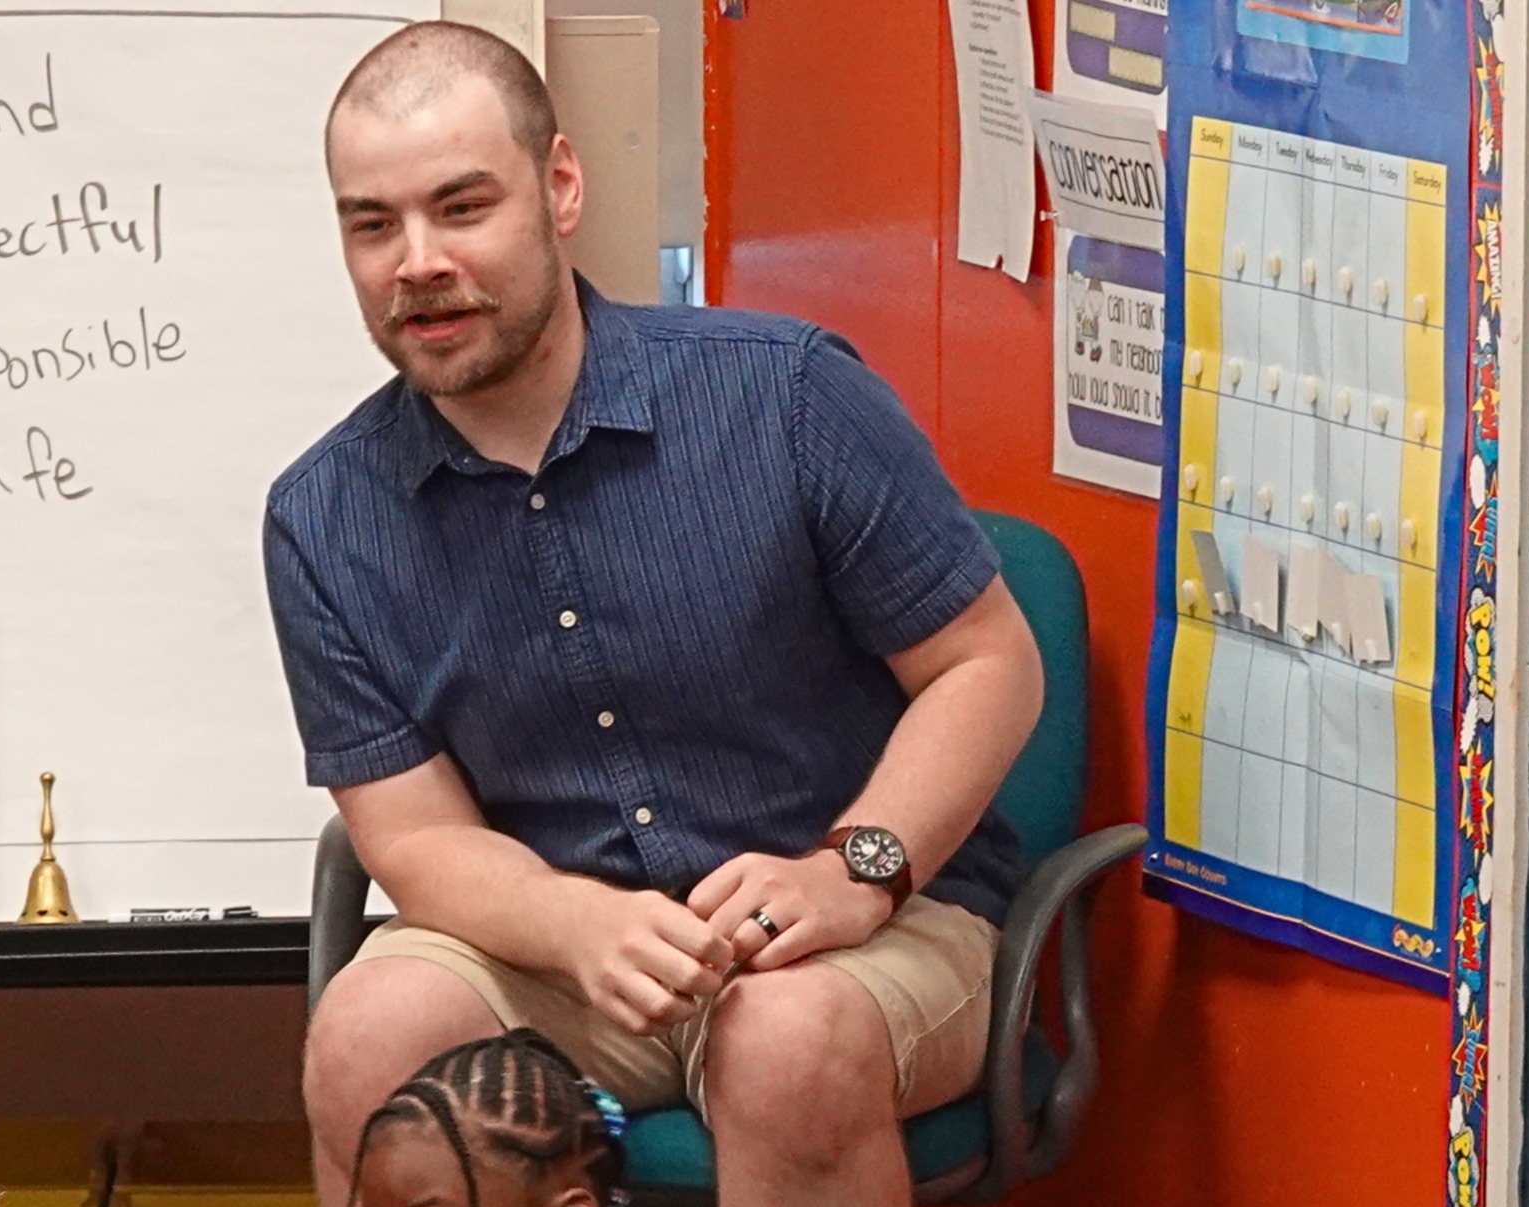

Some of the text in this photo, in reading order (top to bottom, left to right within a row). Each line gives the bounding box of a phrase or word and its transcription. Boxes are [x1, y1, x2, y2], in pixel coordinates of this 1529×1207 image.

[1200, 128, 1224, 149] Sunday
[1238, 135, 1263, 157] Monday
[1276, 141, 1298, 164] Tuesday
[1049, 140, 1162, 211] conversation
[1341, 155, 1366, 179] Thursday
[1378, 163, 1398, 186] Friday
[1413, 170, 1441, 195] Saturday
[1485, 220, 1501, 299] AMAZING!
[1107, 294, 1125, 325] can
[1128, 300, 1132, 328] i
[1136, 301, 1156, 331] talk
[1110, 339, 1122, 367] my
[1090, 378, 1108, 406] loud
[1112, 382, 1140, 414] should
[1144, 389, 1151, 417] it
[1480, 363, 1498, 439] WOW!
[1480, 496, 1497, 564] SUPER!
[1470, 602, 1496, 701] POW!
[1462, 894, 1481, 970] WOW!
[1463, 1028, 1479, 1093] SUPER!
